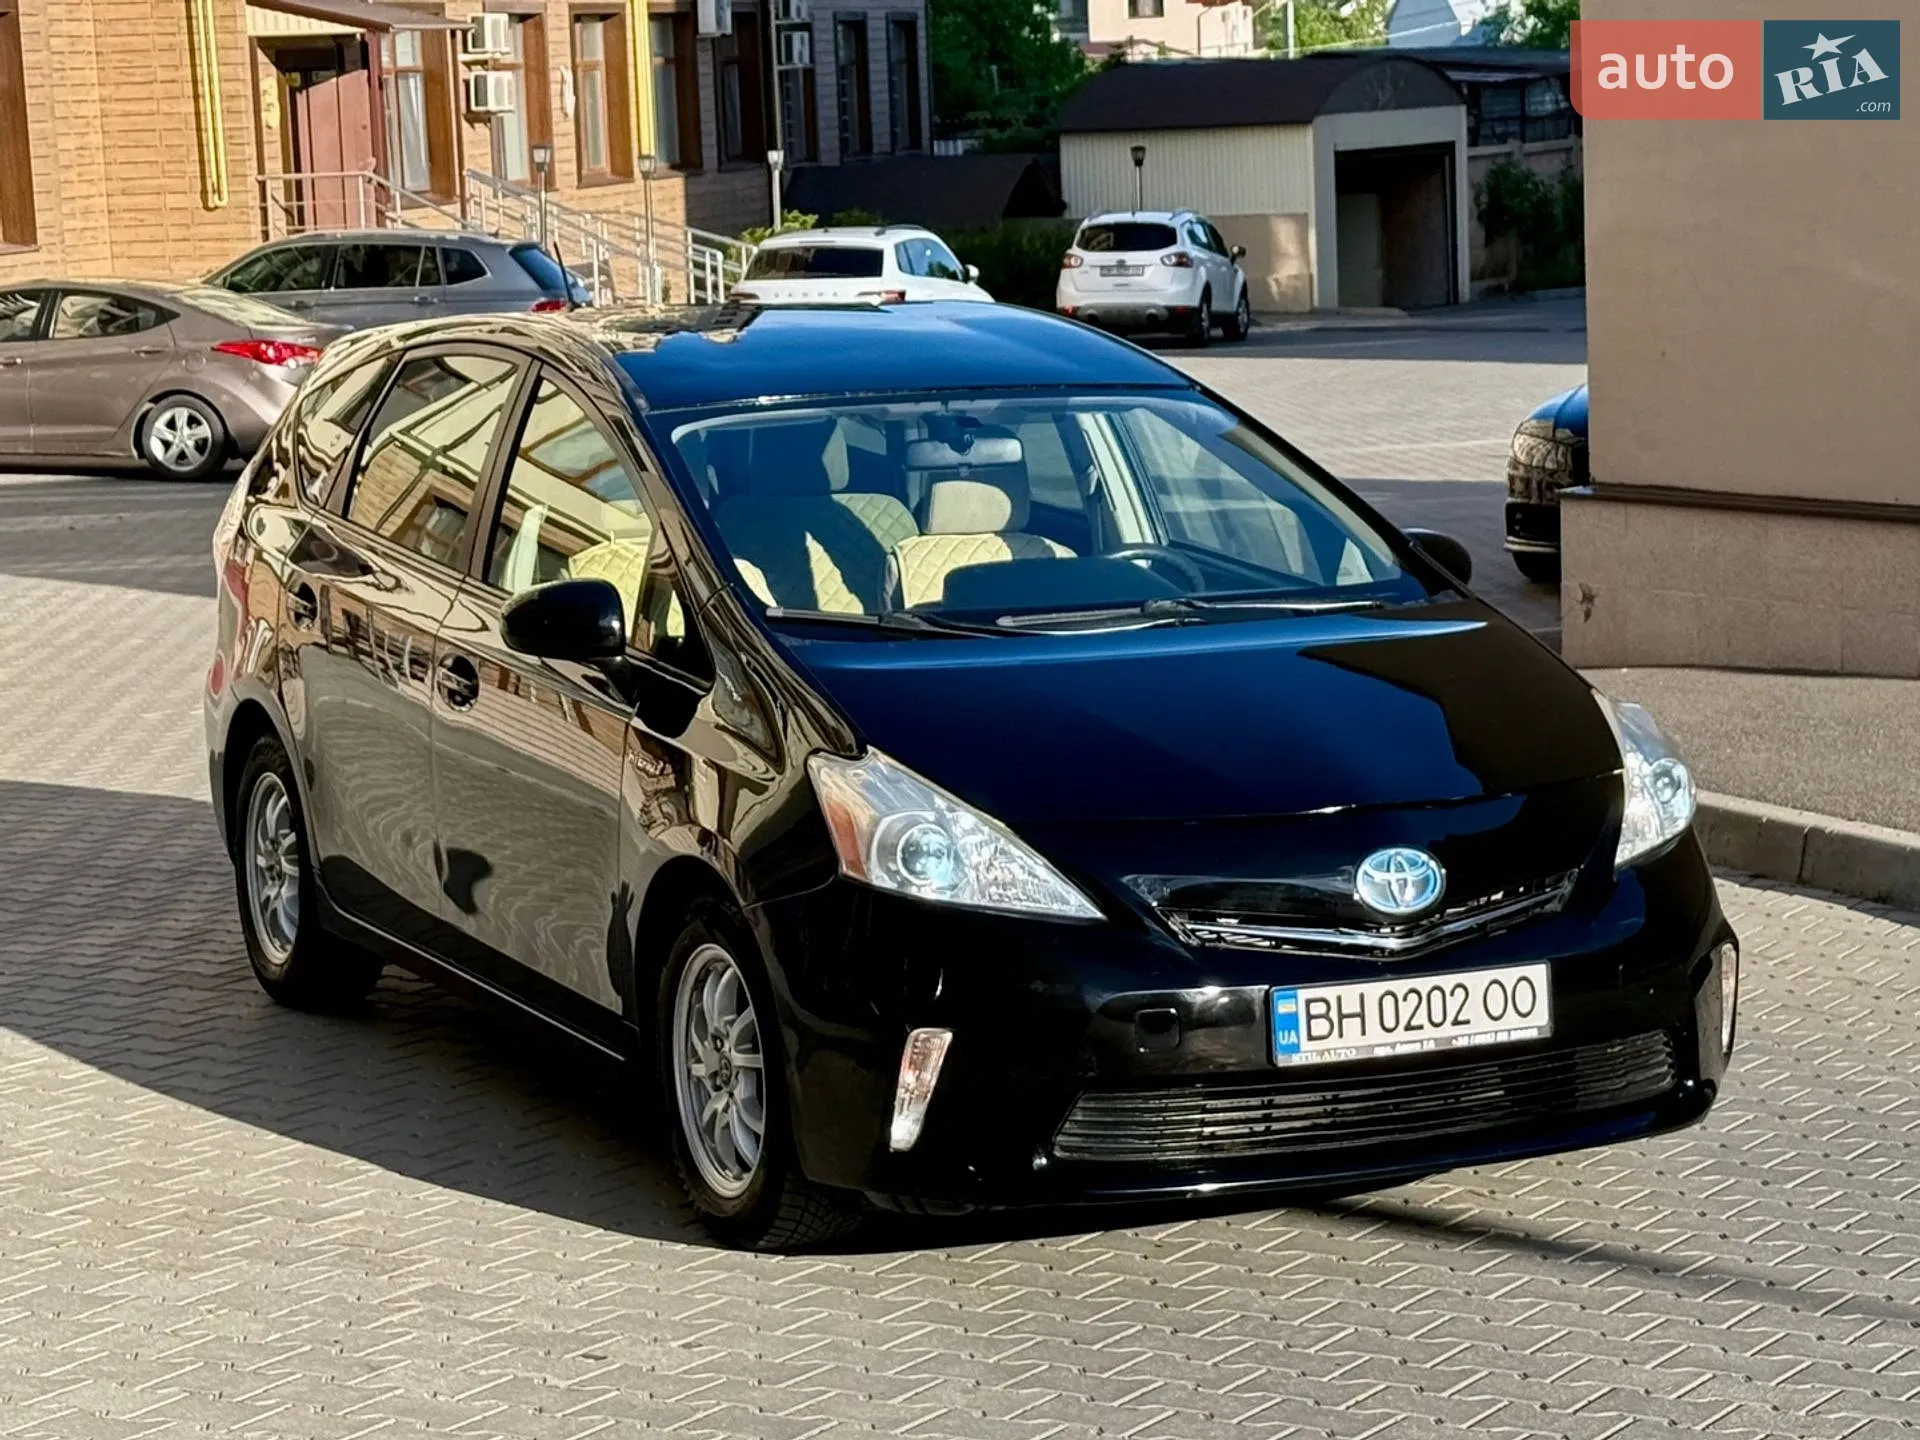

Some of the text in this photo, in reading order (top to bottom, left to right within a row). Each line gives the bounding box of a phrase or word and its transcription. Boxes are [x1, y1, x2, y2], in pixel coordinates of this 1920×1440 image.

[1305, 975, 1537, 1042] BH 0202 OO
[1279, 1029, 1298, 1045] UA
